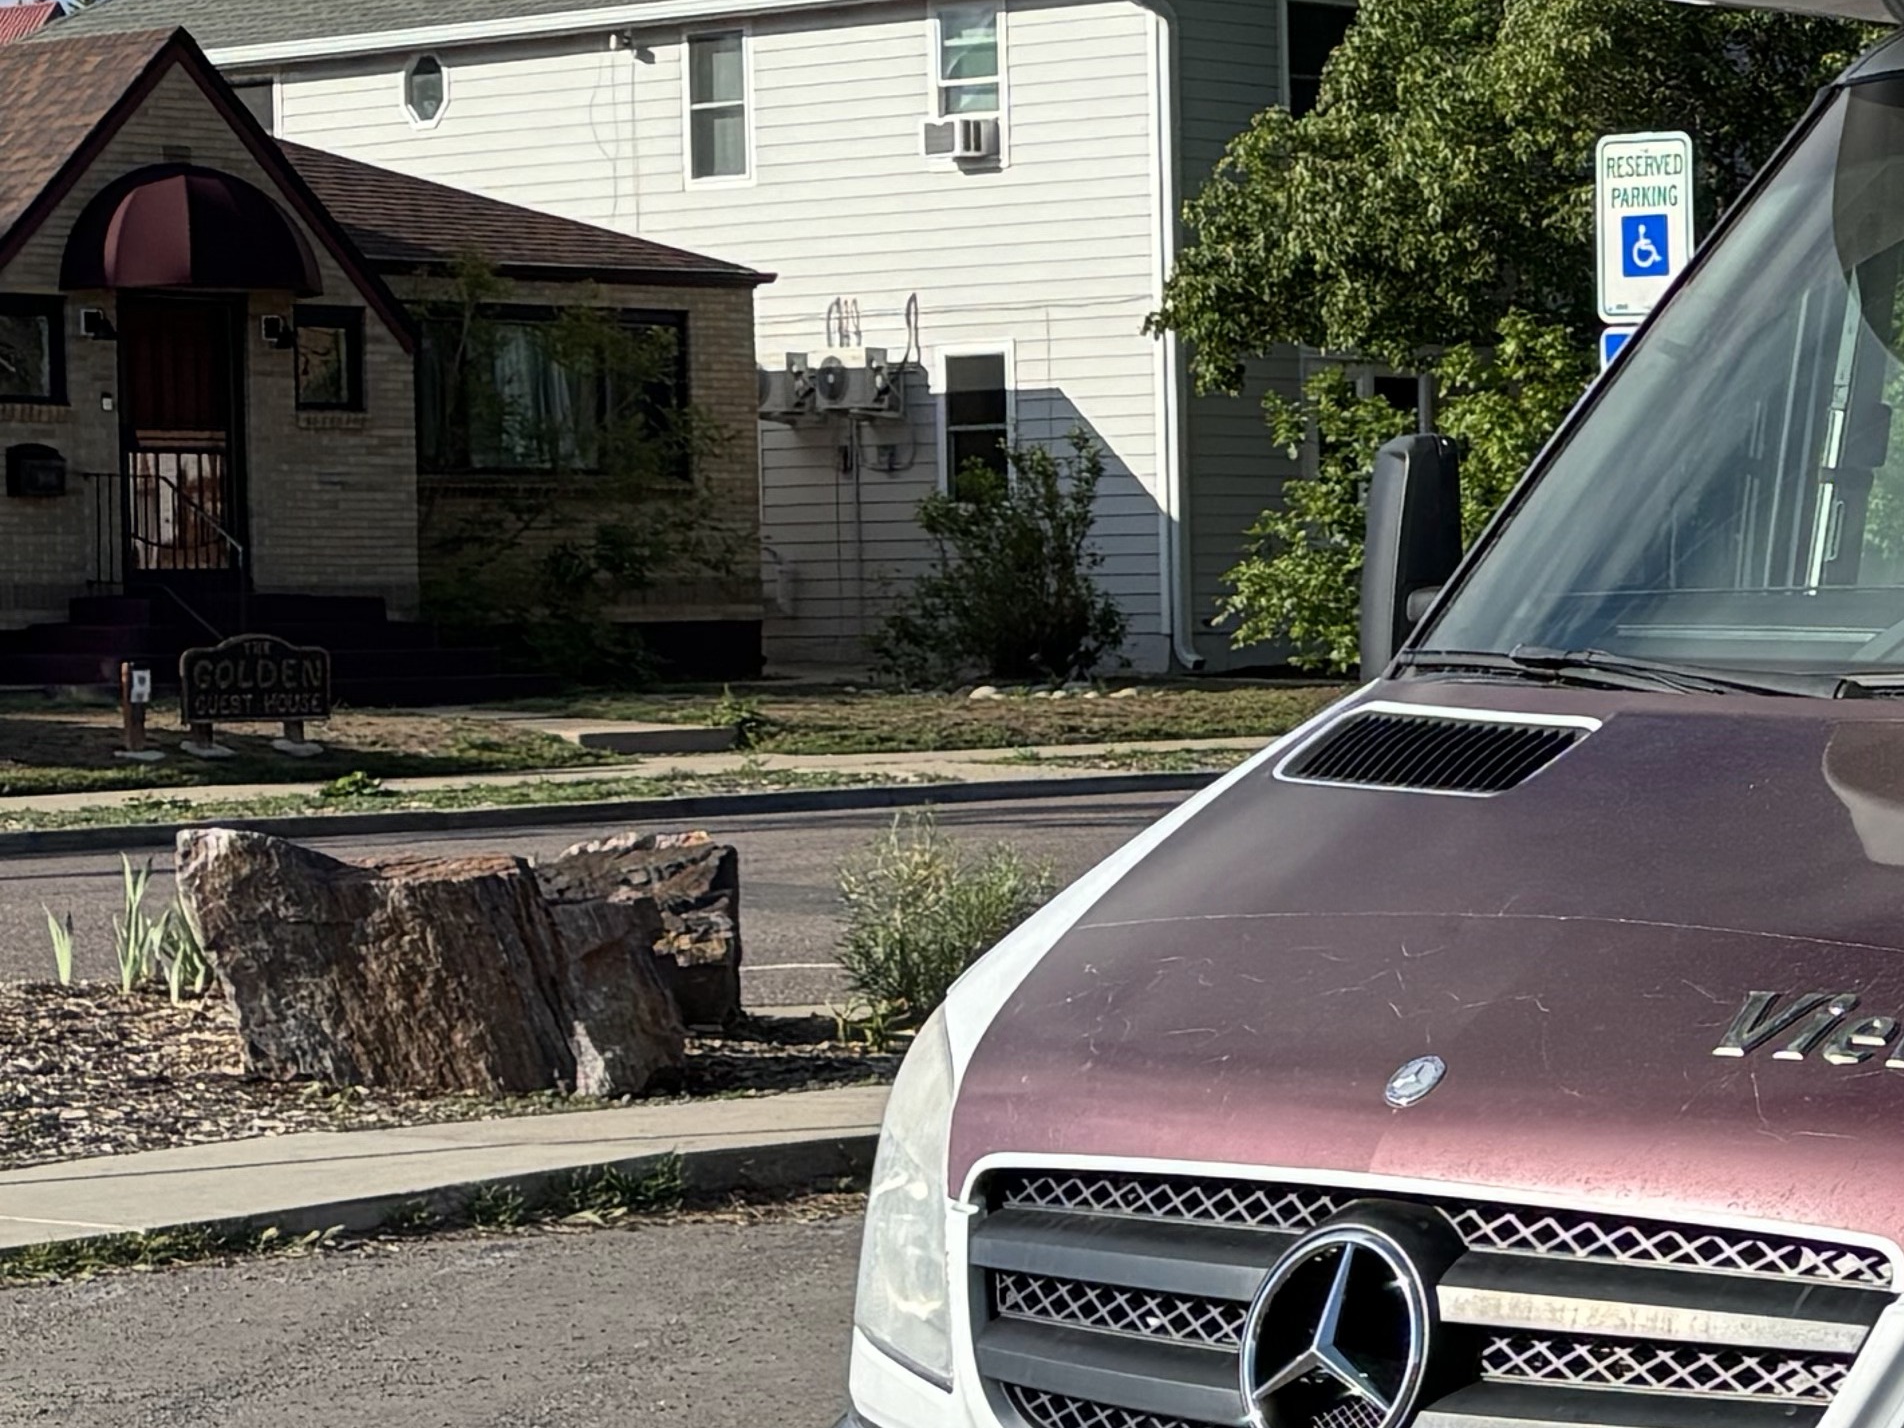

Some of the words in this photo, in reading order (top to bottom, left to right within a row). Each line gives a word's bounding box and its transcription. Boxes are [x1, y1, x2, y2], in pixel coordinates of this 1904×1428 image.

[1606, 153, 1683, 179] RESERVED
[1610, 185, 1678, 209] PARKING
[192, 658, 323, 690] GOLDEN
[194, 693, 253, 715] GUEST
[263, 692, 323, 714] HOUSE
